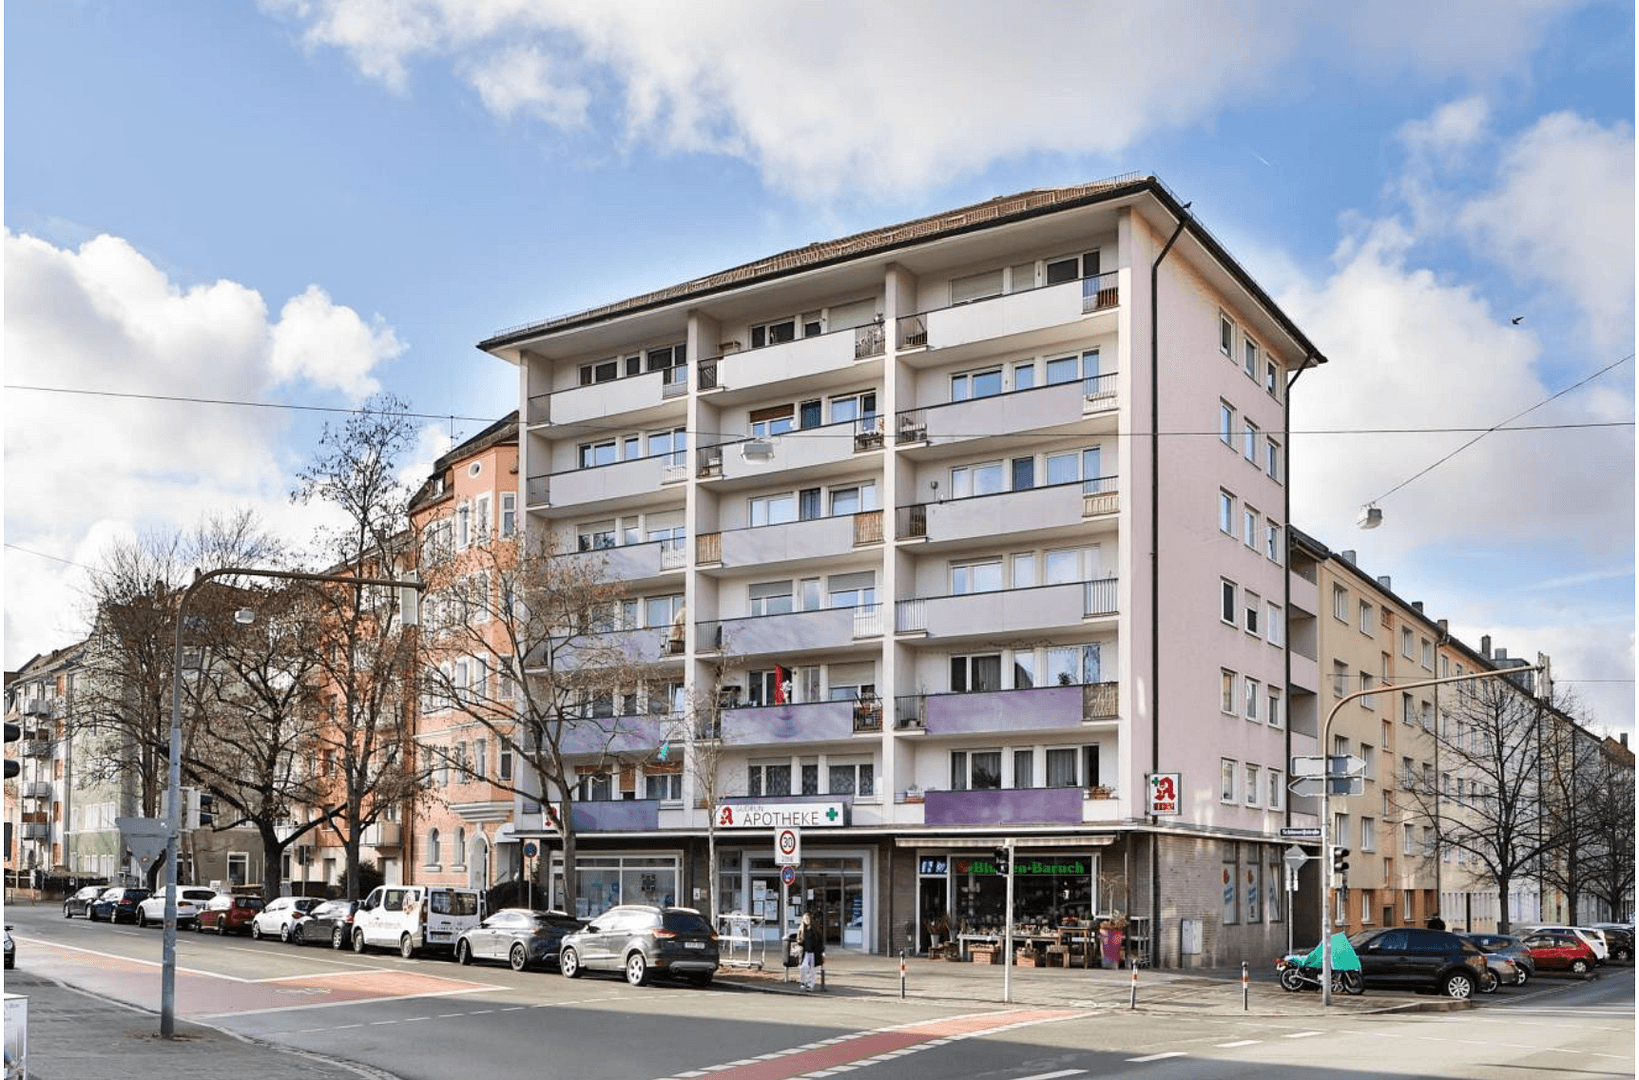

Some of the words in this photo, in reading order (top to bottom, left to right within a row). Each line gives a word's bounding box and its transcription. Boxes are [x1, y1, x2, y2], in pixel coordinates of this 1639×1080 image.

[743, 811, 820, 826] APOTHEKE
[782, 836, 794, 849] 30
[968, 861, 1085, 876] Bluen-Baruch
